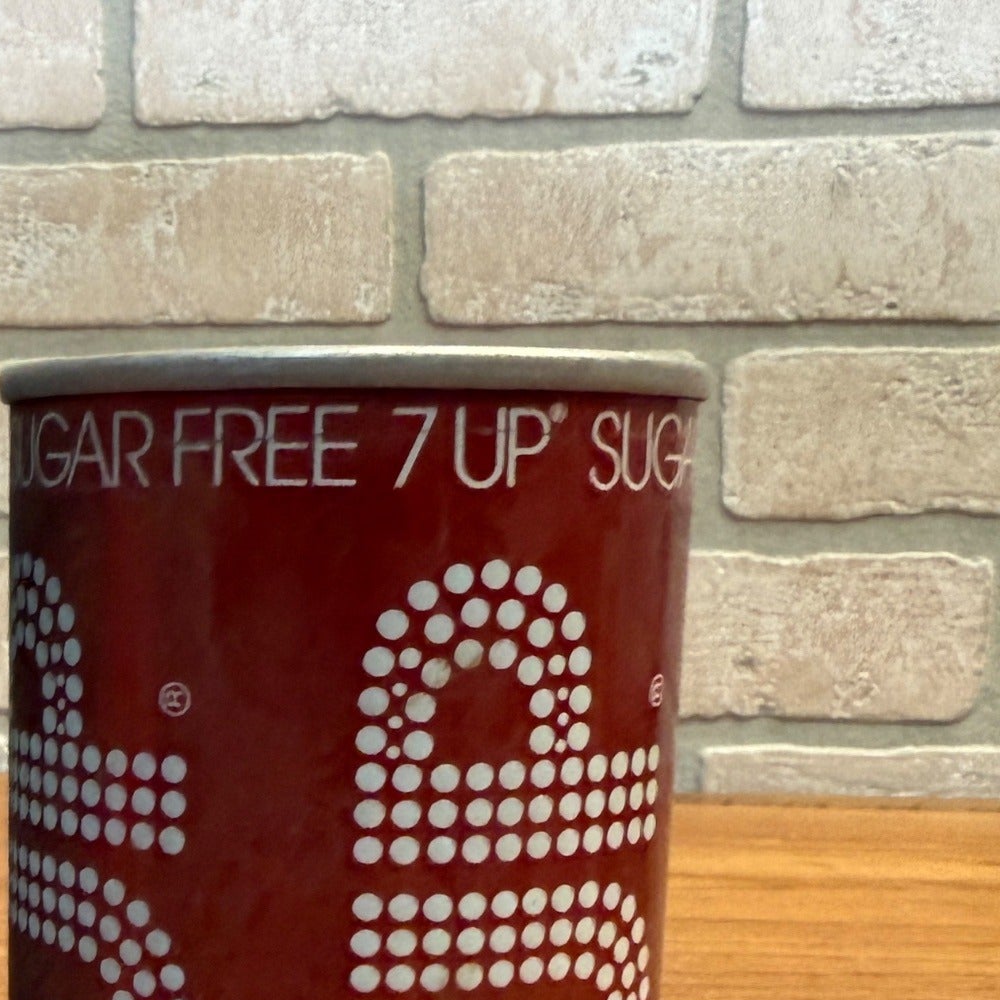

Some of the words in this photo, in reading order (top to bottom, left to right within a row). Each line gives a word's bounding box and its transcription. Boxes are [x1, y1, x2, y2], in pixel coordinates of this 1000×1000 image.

[14, 409, 154, 489] UGAR
[173, 403, 359, 488] FREE
[391, 405, 439, 490] 7
[453, 405, 553, 490] UP
